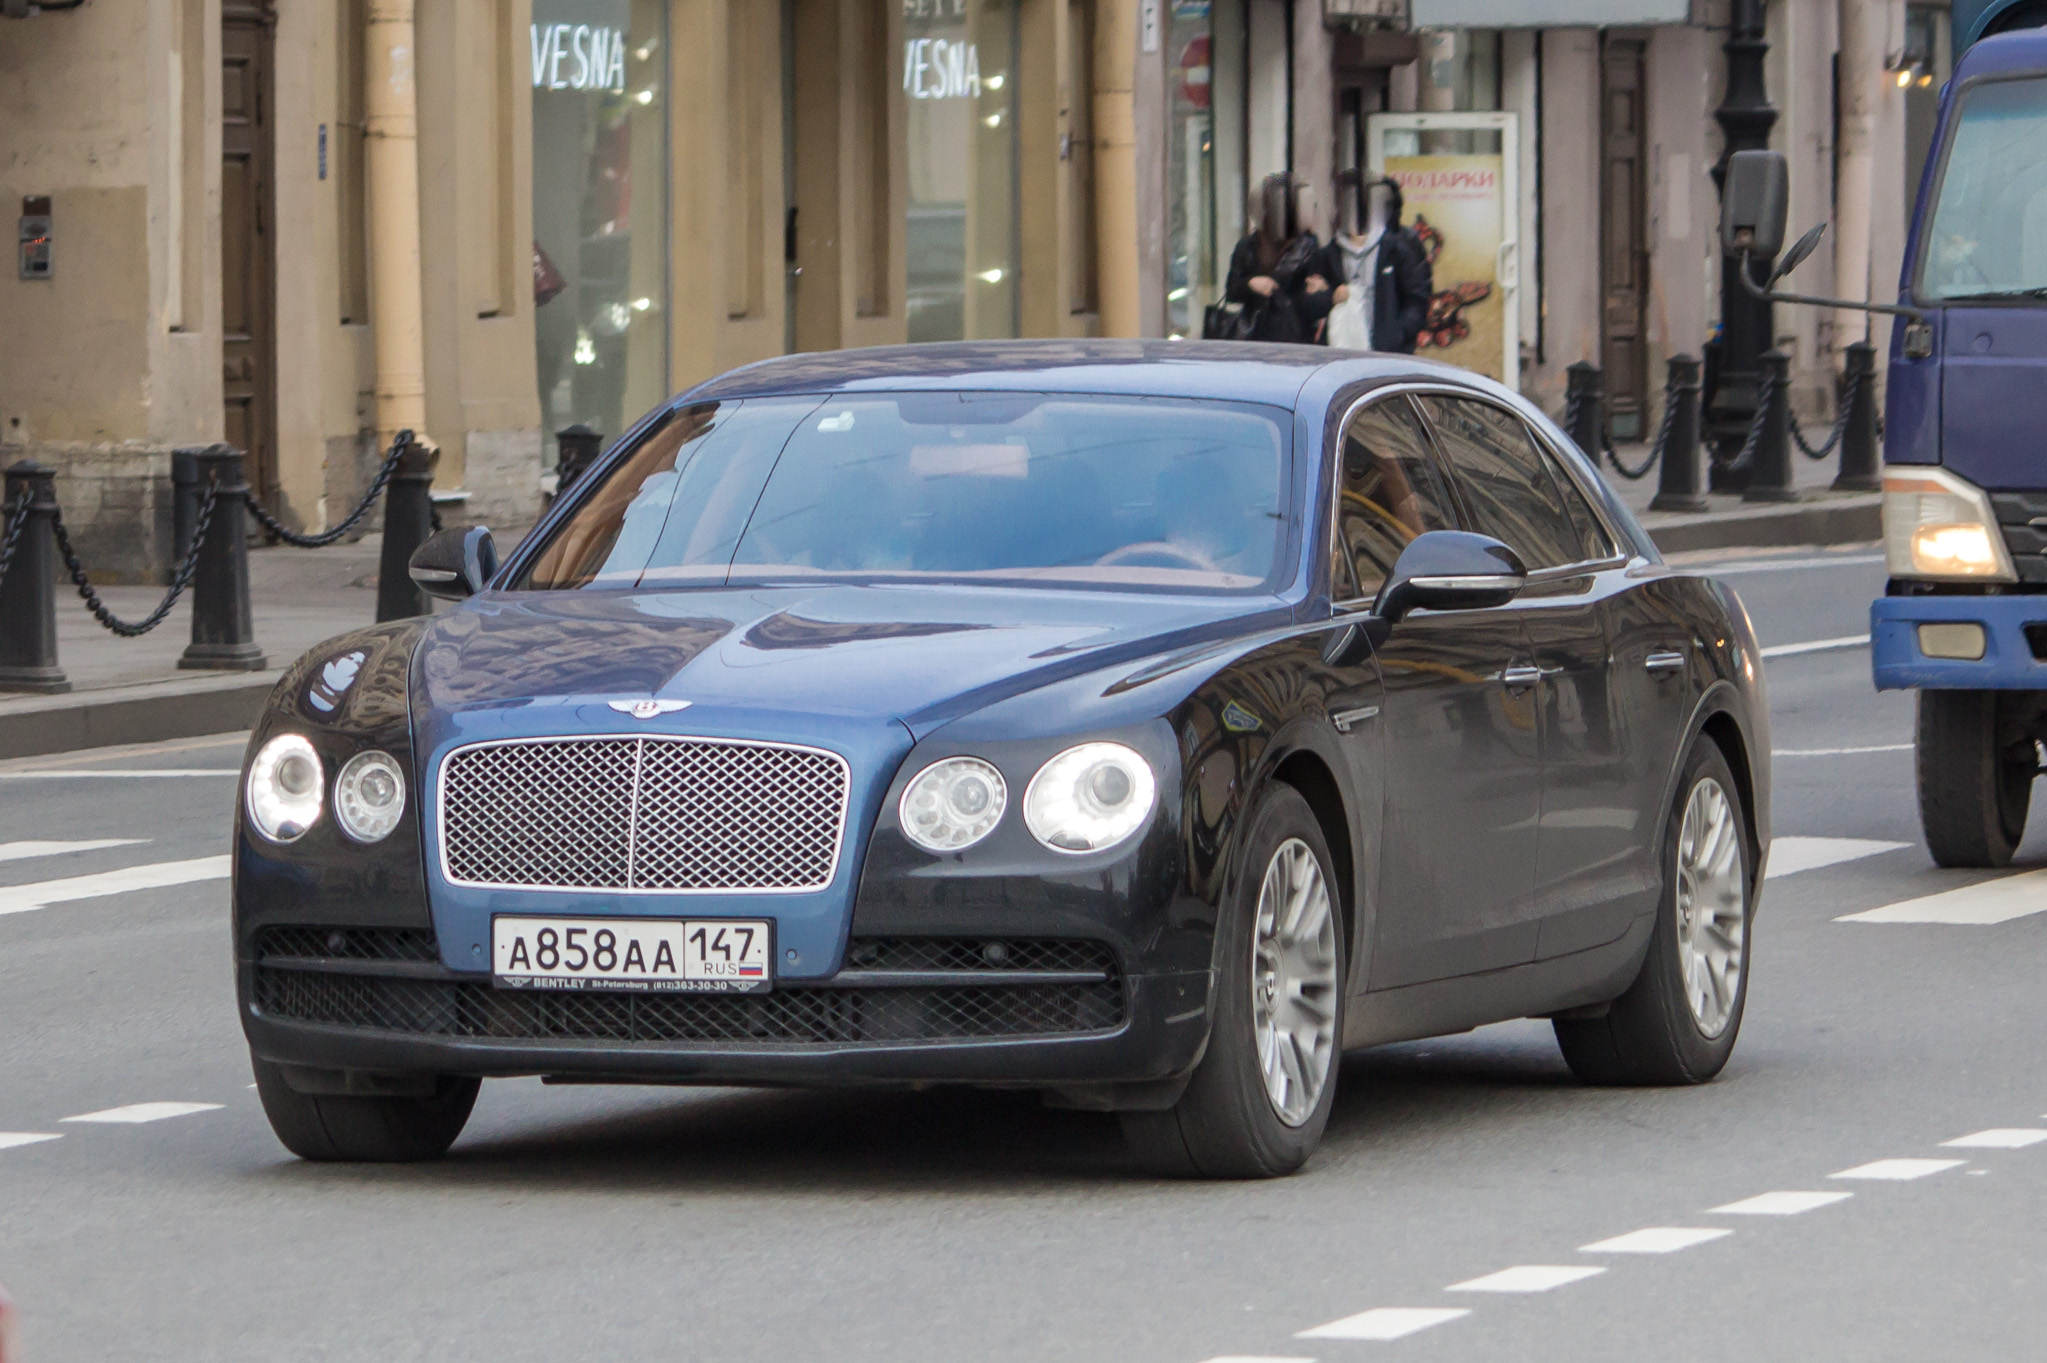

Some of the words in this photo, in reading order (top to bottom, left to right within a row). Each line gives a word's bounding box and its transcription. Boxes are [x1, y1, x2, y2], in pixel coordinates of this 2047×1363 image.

[529, 24, 625, 89] VESNA
[509, 927, 676, 973] A858AA
[689, 928, 754, 961] 147
[533, 977, 586, 988] BENTLEY
[704, 962, 737, 975] RUS
